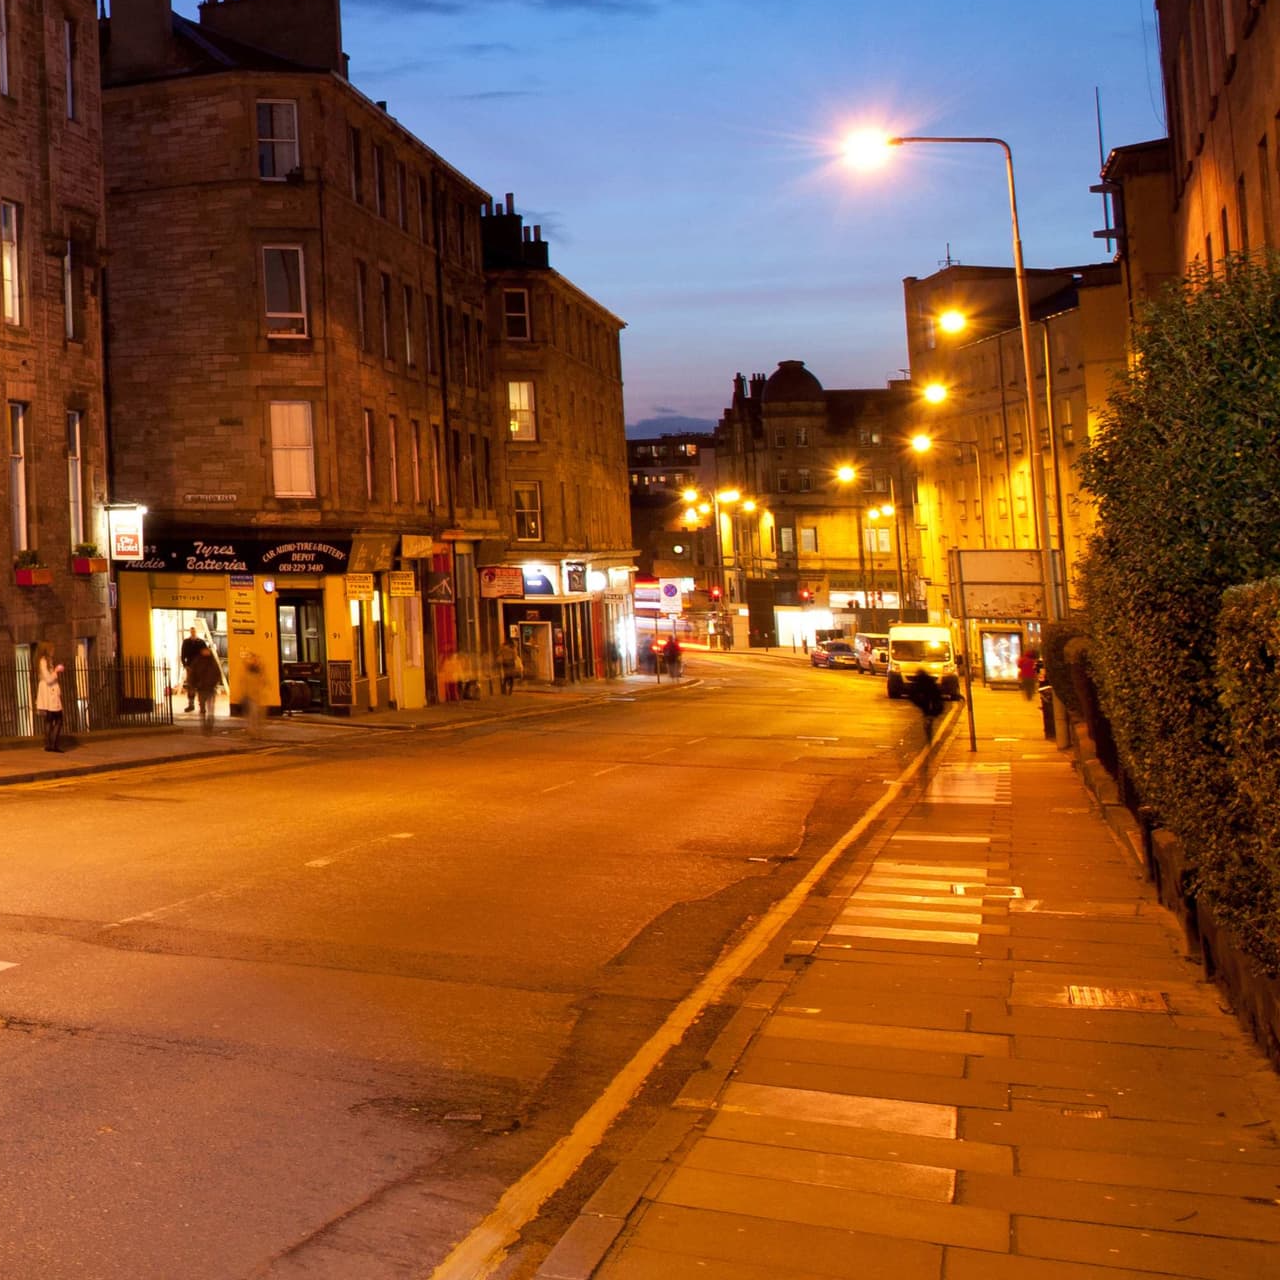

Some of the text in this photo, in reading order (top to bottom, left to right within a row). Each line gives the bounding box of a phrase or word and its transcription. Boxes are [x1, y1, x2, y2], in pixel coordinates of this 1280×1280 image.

[193, 541, 236, 557] Tyres
[186, 556, 248, 571] Batteries
[262, 550, 277, 563] CAR
[291, 553, 316, 562] DEPOT
